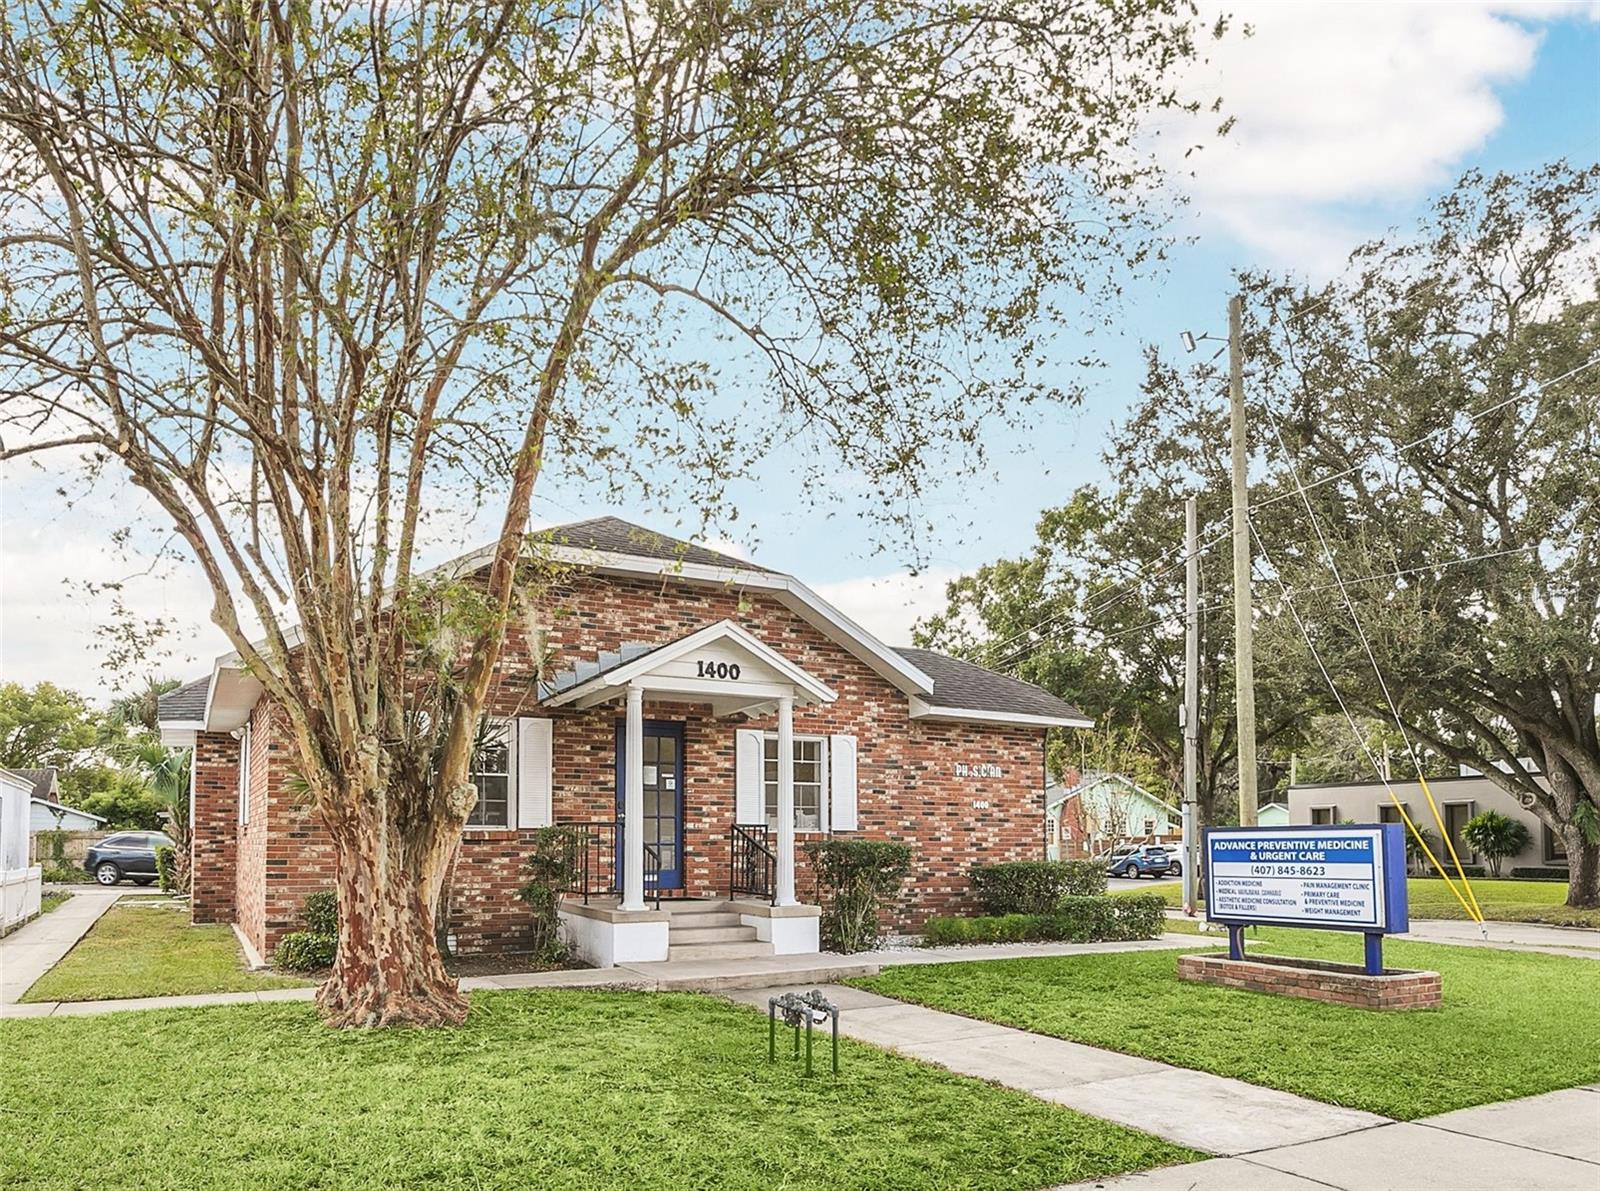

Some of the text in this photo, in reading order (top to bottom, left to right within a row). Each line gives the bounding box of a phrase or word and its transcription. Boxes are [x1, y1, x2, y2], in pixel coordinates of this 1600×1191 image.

[697, 661, 740, 680] 1400
[1214, 840, 1368, 850] ADVANCE PREVENTIVE MEDICINE
[1250, 851, 1325, 860] & URGENT CARE
[1251, 865, 1325, 876] (407) 845-8623
